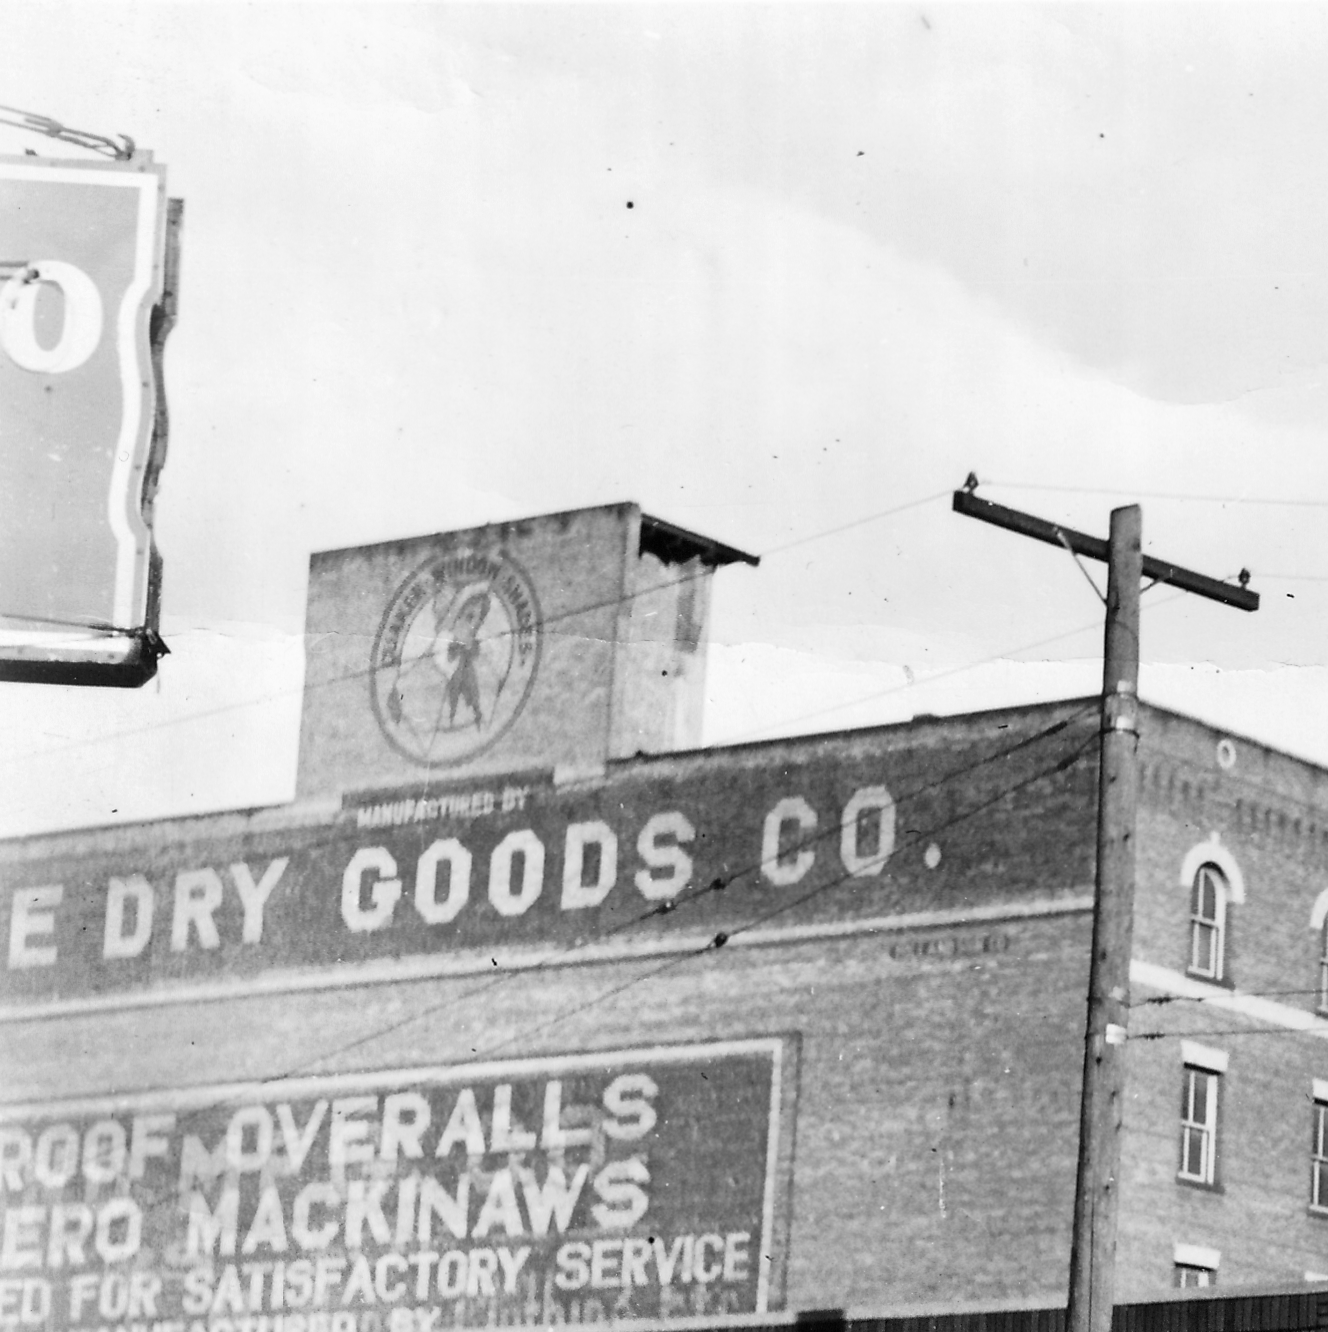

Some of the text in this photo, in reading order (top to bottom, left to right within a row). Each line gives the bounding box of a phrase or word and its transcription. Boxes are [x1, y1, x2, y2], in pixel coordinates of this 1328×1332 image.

[8, 786, 941, 969] E DRY GOODS CO.
[0, 1113, 177, 1193] ROOF
[226, 1074, 658, 1172] OVERALLS
[1, 1198, 142, 1269] ERO
[186, 1156, 650, 1256] MACKINAWS
[70, 1271, 163, 1321] FOR
[183, 1247, 532, 1314] SATISFACTORY
[555, 1231, 750, 1290] SERVICE
